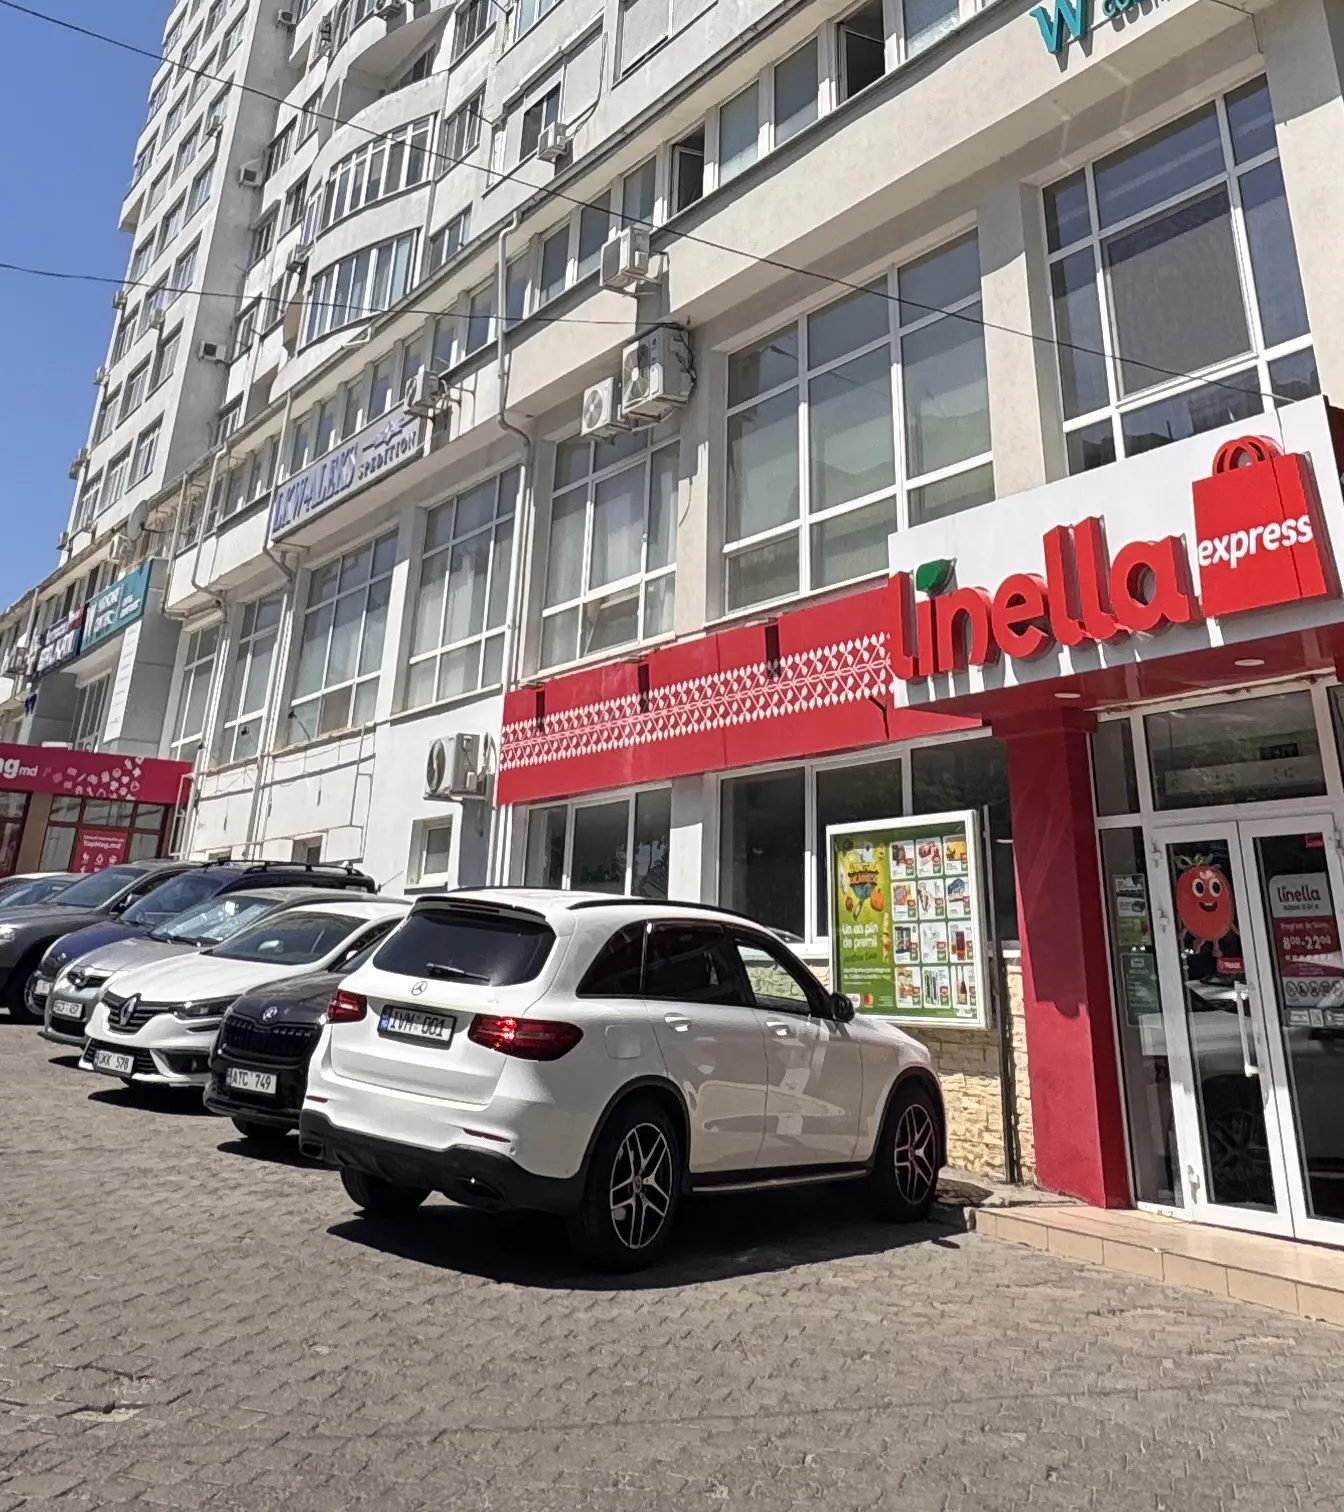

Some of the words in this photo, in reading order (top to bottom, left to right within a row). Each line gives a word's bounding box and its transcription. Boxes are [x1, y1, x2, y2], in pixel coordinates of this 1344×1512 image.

[358, 430, 416, 481] SPEDITION
[1197, 512, 1313, 569] express
[887, 514, 1200, 681] linella
[1276, 883, 1321, 903] linella
